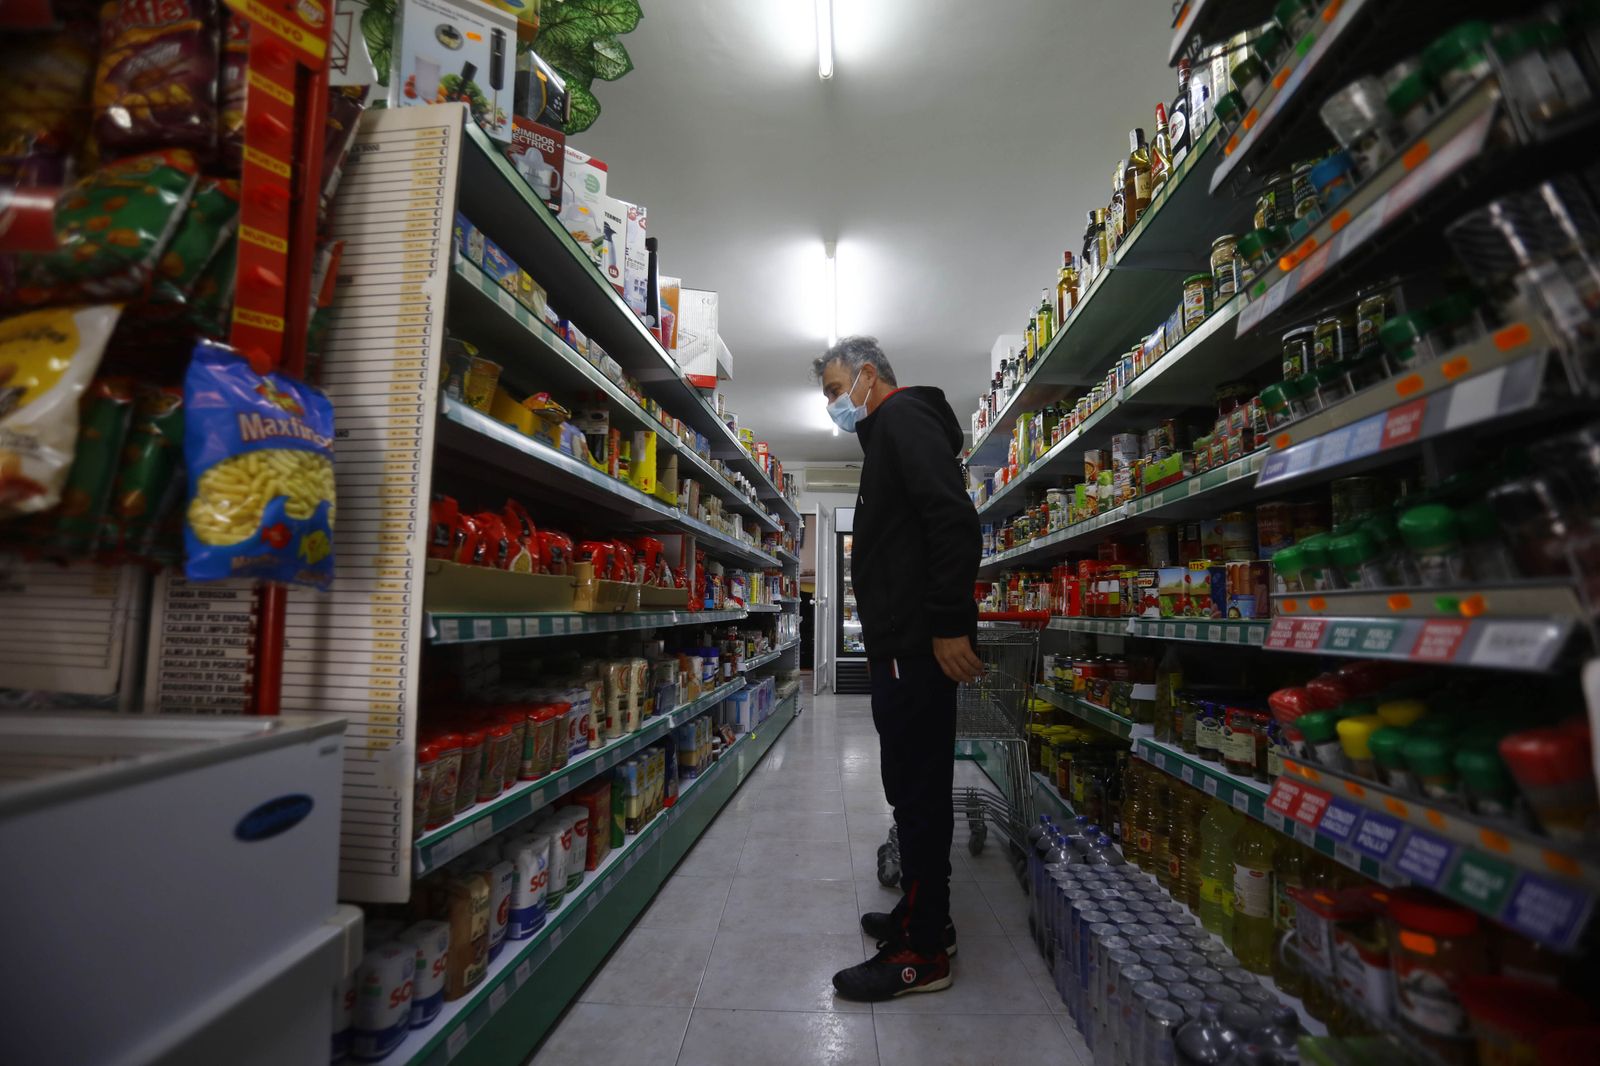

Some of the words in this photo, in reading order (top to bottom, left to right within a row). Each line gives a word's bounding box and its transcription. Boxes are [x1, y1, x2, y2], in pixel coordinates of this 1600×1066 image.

[246, 1, 303, 42] NUEVO
[513, 127, 555, 147] RIMIDOR
[237, 311, 282, 330] NUEVO
[1356, 832, 1390, 854] POLLO
